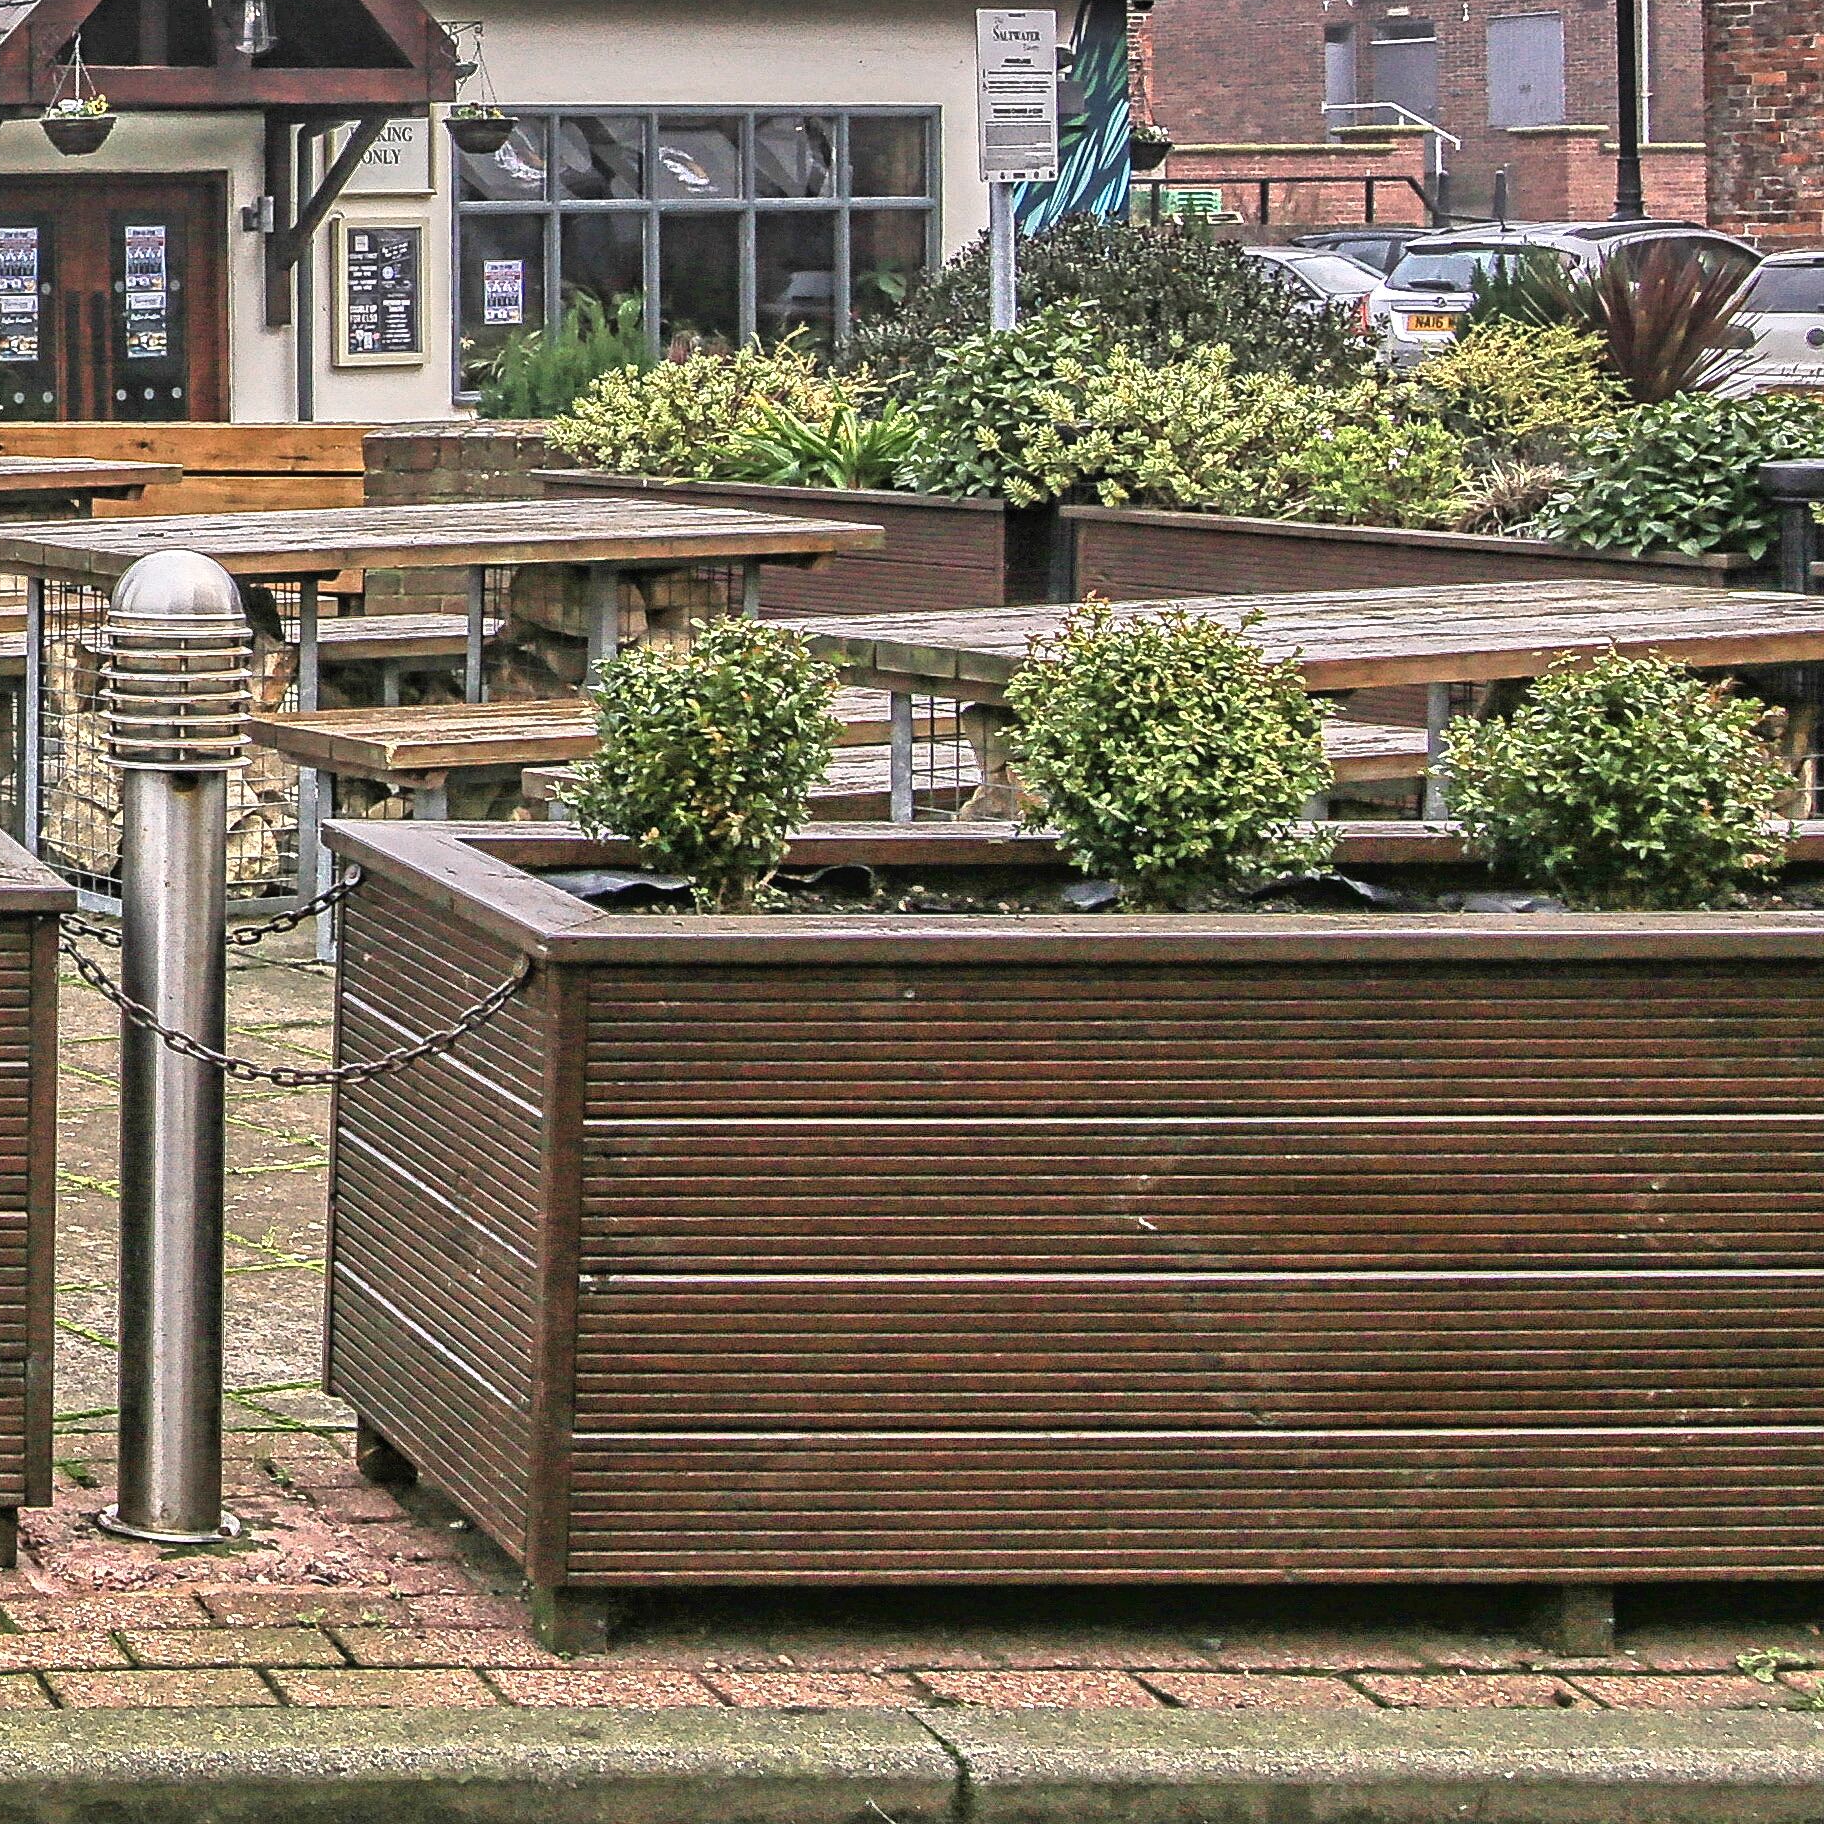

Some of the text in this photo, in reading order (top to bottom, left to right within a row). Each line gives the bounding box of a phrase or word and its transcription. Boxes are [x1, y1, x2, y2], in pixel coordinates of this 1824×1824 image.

[993, 24, 1041, 42] SALTWATER
[362, 149, 401, 165] ONLY
[1414, 316, 1444, 329] NA16
